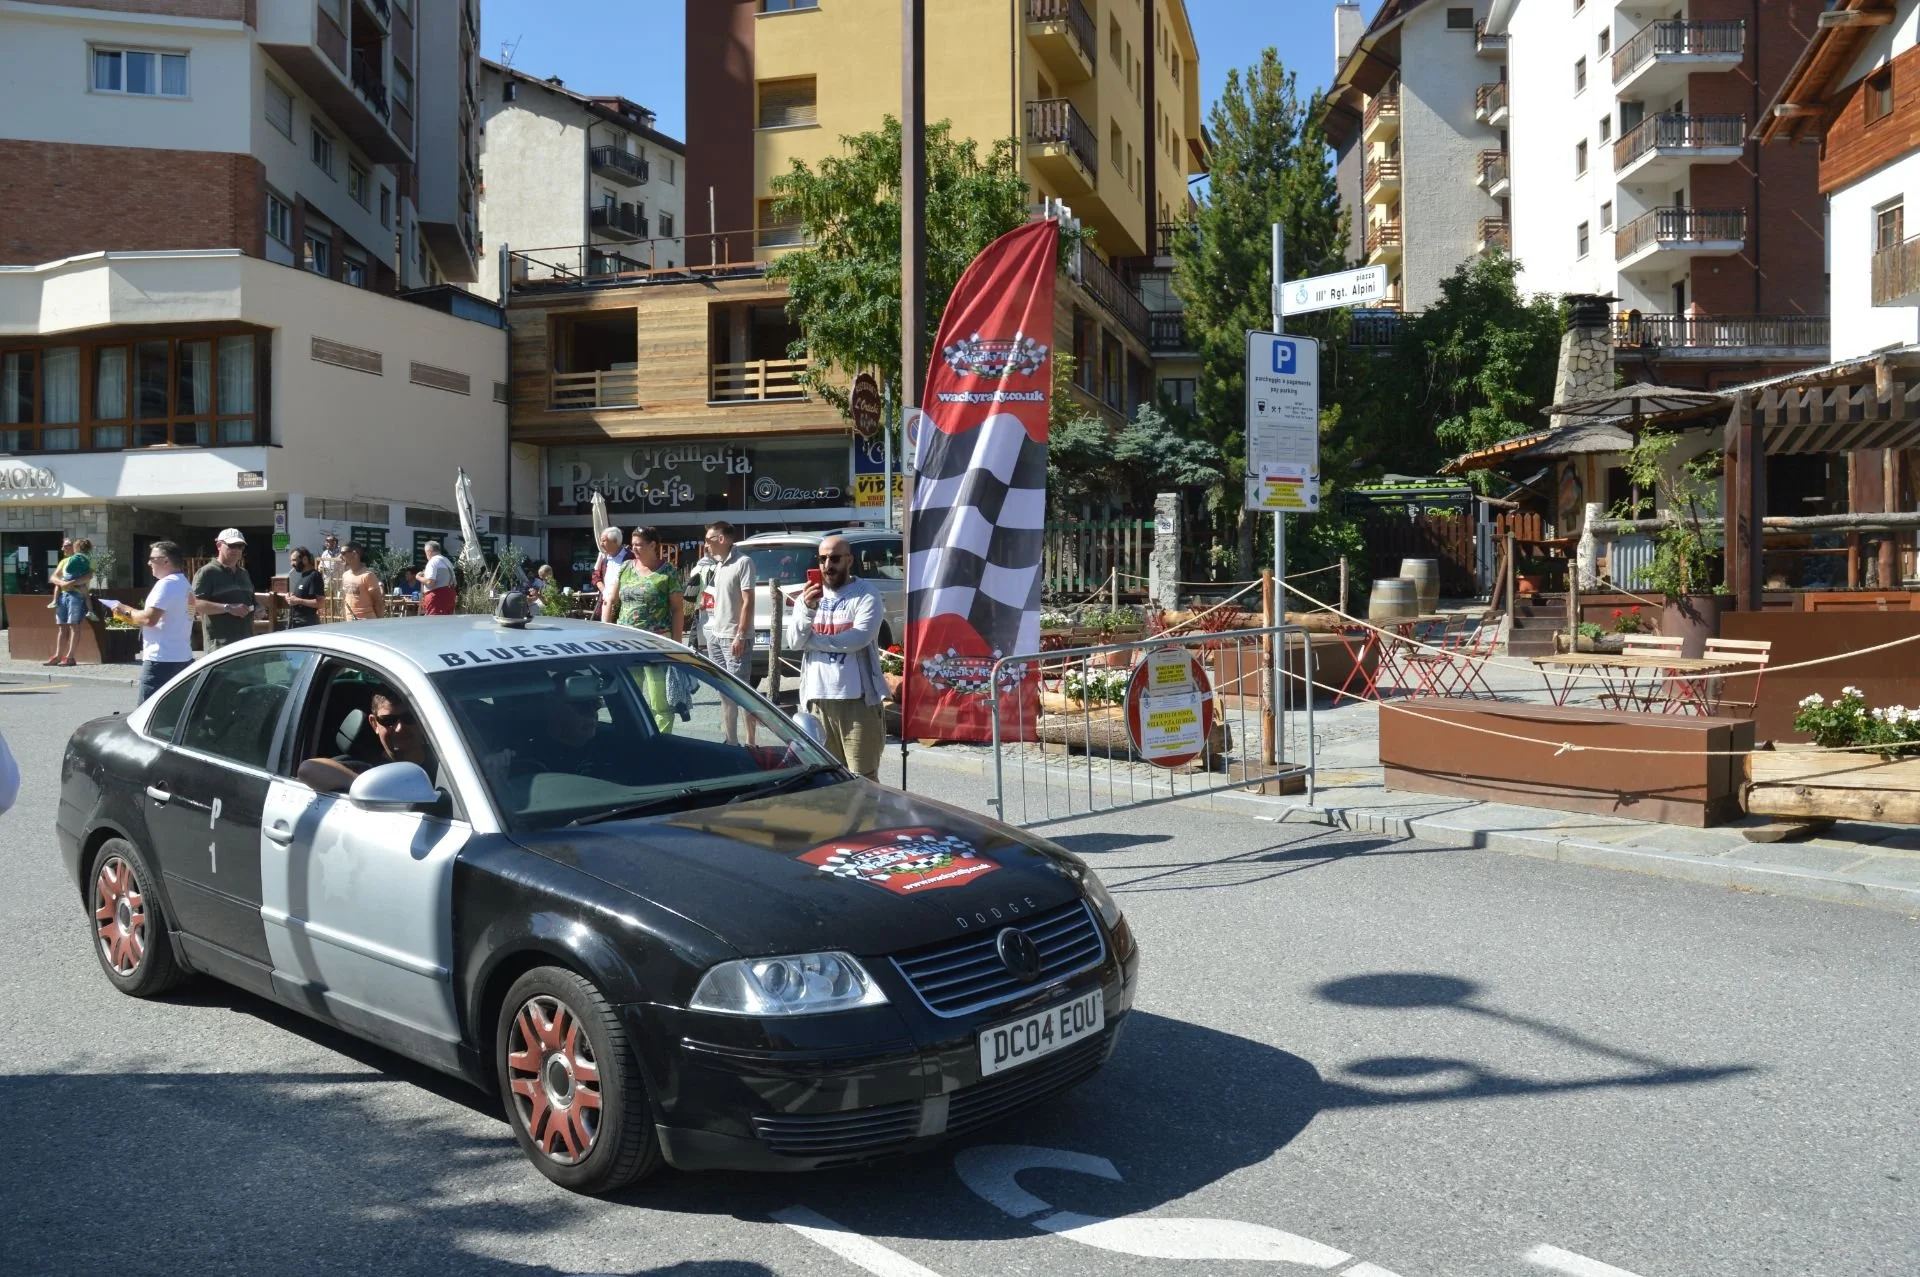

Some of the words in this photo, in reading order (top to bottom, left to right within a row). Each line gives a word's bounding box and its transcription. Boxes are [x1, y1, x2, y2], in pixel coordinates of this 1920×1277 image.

[1356, 272, 1375, 282] piazza
[1330, 288, 1348, 300] Rgt.
[1352, 282, 1376, 296] Alpini
[961, 351, 999, 363] Wacky
[1277, 345, 1292, 369] P
[938, 391, 1045, 404] wackyrally.co.uk
[623, 443, 752, 481] Cremeria
[559, 461, 695, 507] Pasticceria
[438, 639, 672, 667] BLUESMOBILE
[938, 668, 977, 677] Wacky
[209, 797, 222, 830] P
[956, 897, 1036, 928] DODGE
[994, 1014, 1054, 1064] DC04
